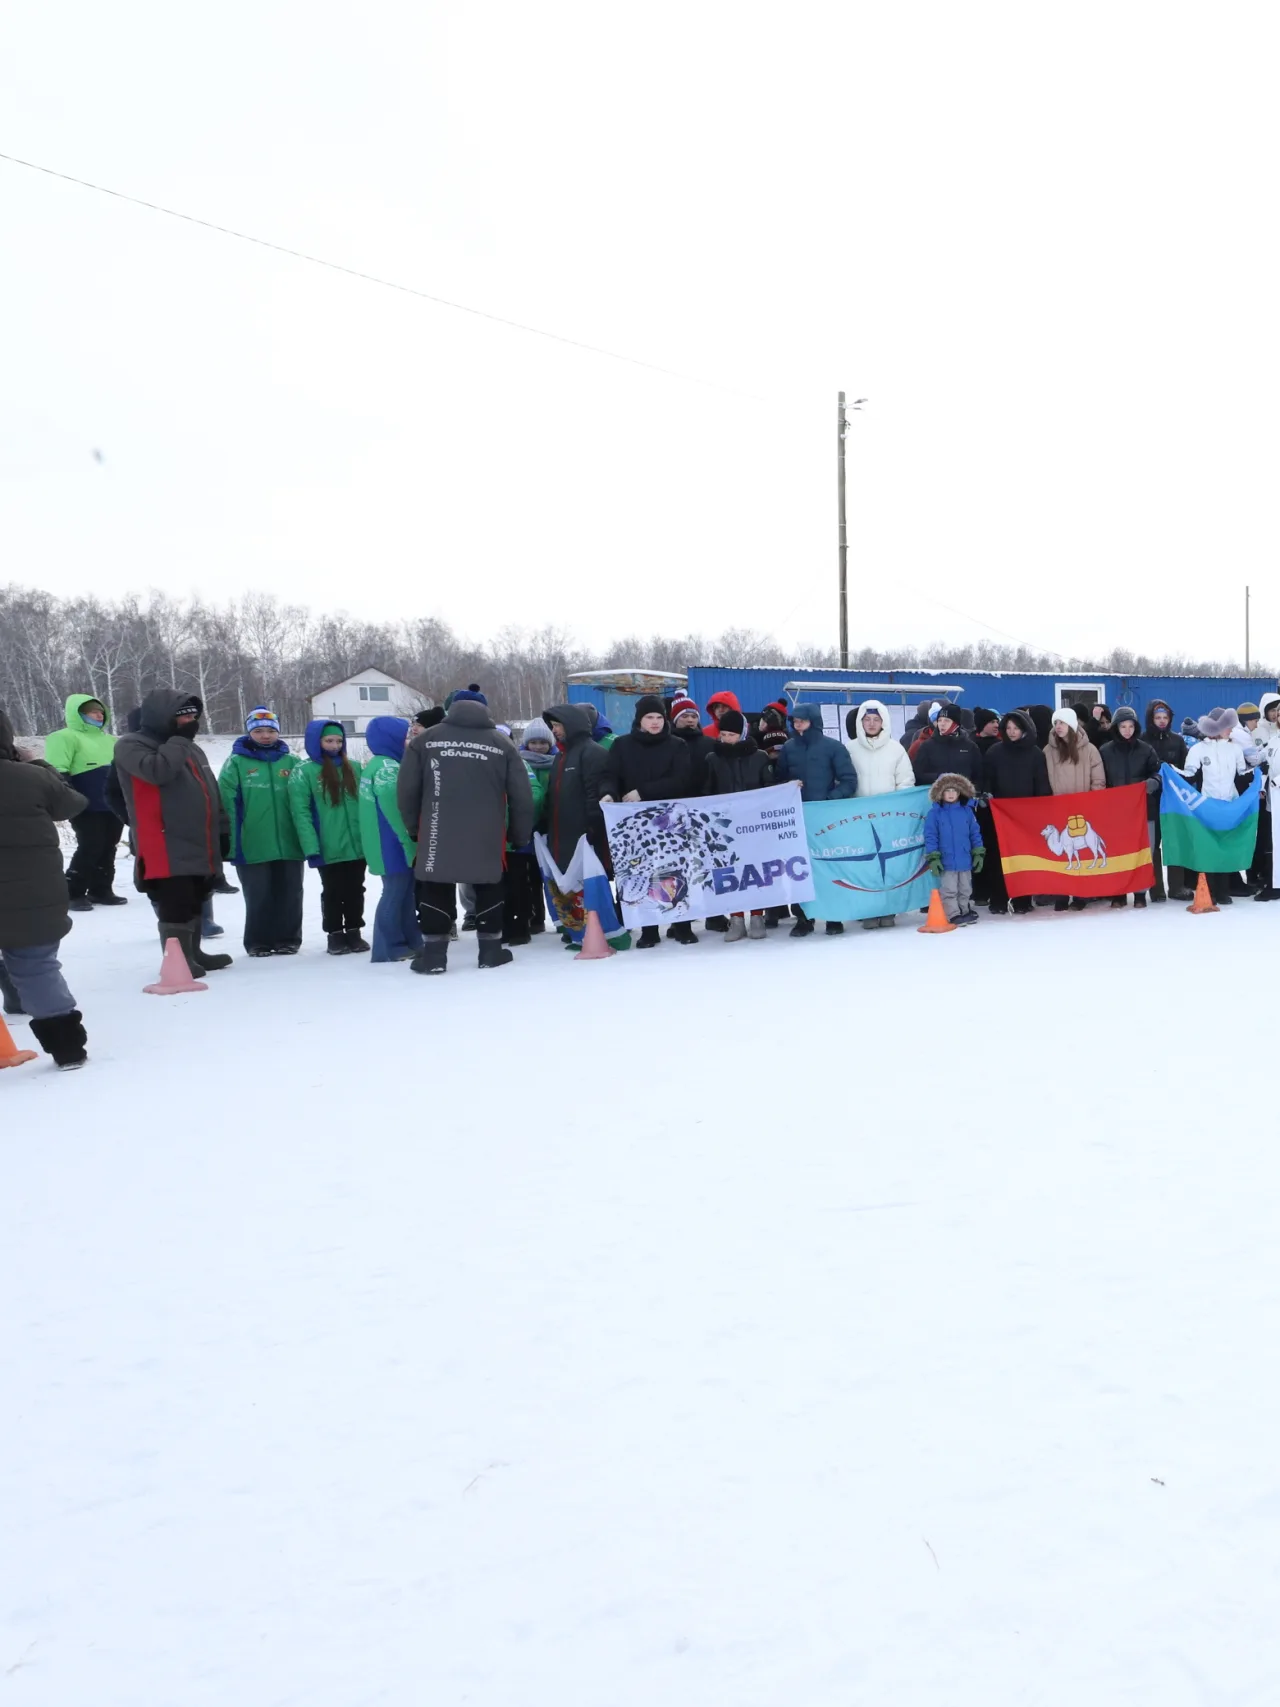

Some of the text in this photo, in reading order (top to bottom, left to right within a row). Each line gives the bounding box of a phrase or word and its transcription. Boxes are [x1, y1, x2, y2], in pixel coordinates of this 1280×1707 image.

[425, 740, 504, 756] Свердловская
[440, 749, 489, 761] область
[760, 806, 796, 820] ВОЕННО
[735, 817, 796, 835] СПОРТИВНЫЙ
[778, 830, 798, 841] КЛУБ
[711, 855, 810, 896] БАРС
